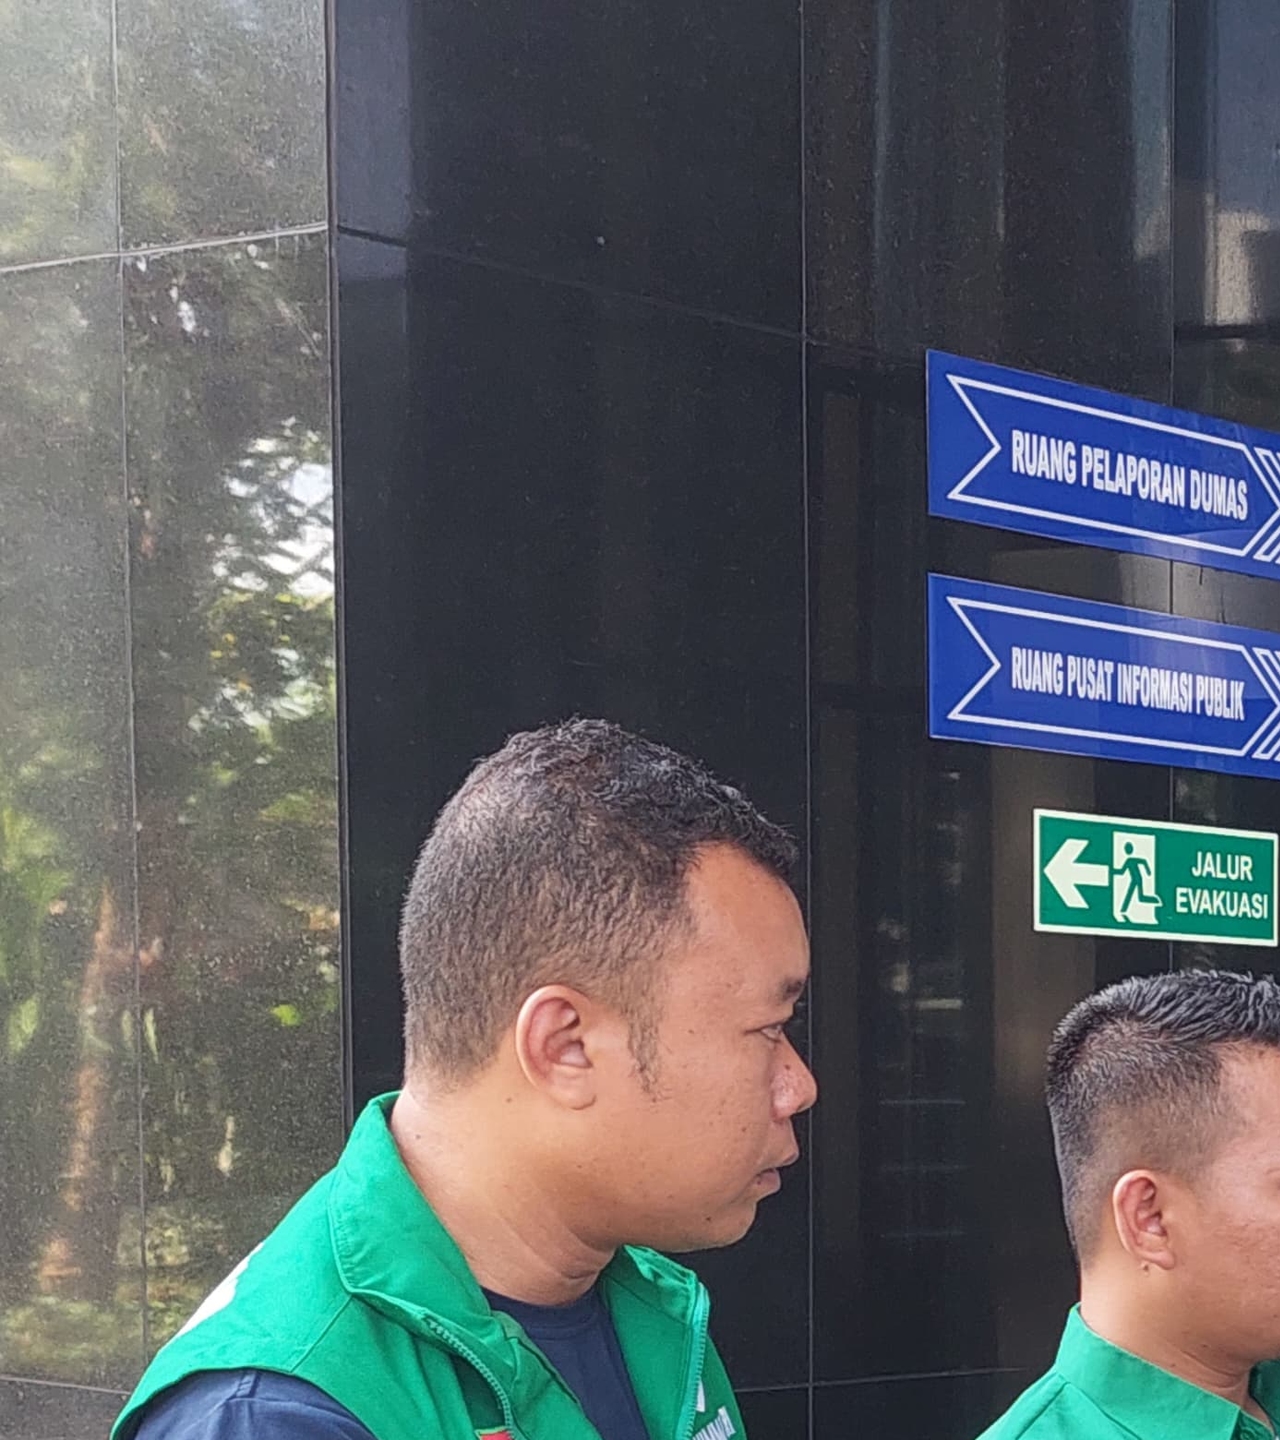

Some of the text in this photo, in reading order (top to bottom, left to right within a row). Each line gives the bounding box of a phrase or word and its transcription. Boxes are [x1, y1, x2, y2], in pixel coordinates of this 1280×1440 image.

[1012, 429, 1248, 521] RUANG PELAPORAN DUMAS
[1012, 646, 1245, 721] RUANG PUSAT INFORMASI PUBLIK
[1192, 851, 1253, 881] JALUR
[1176, 886, 1268, 919] EVAKUASI
